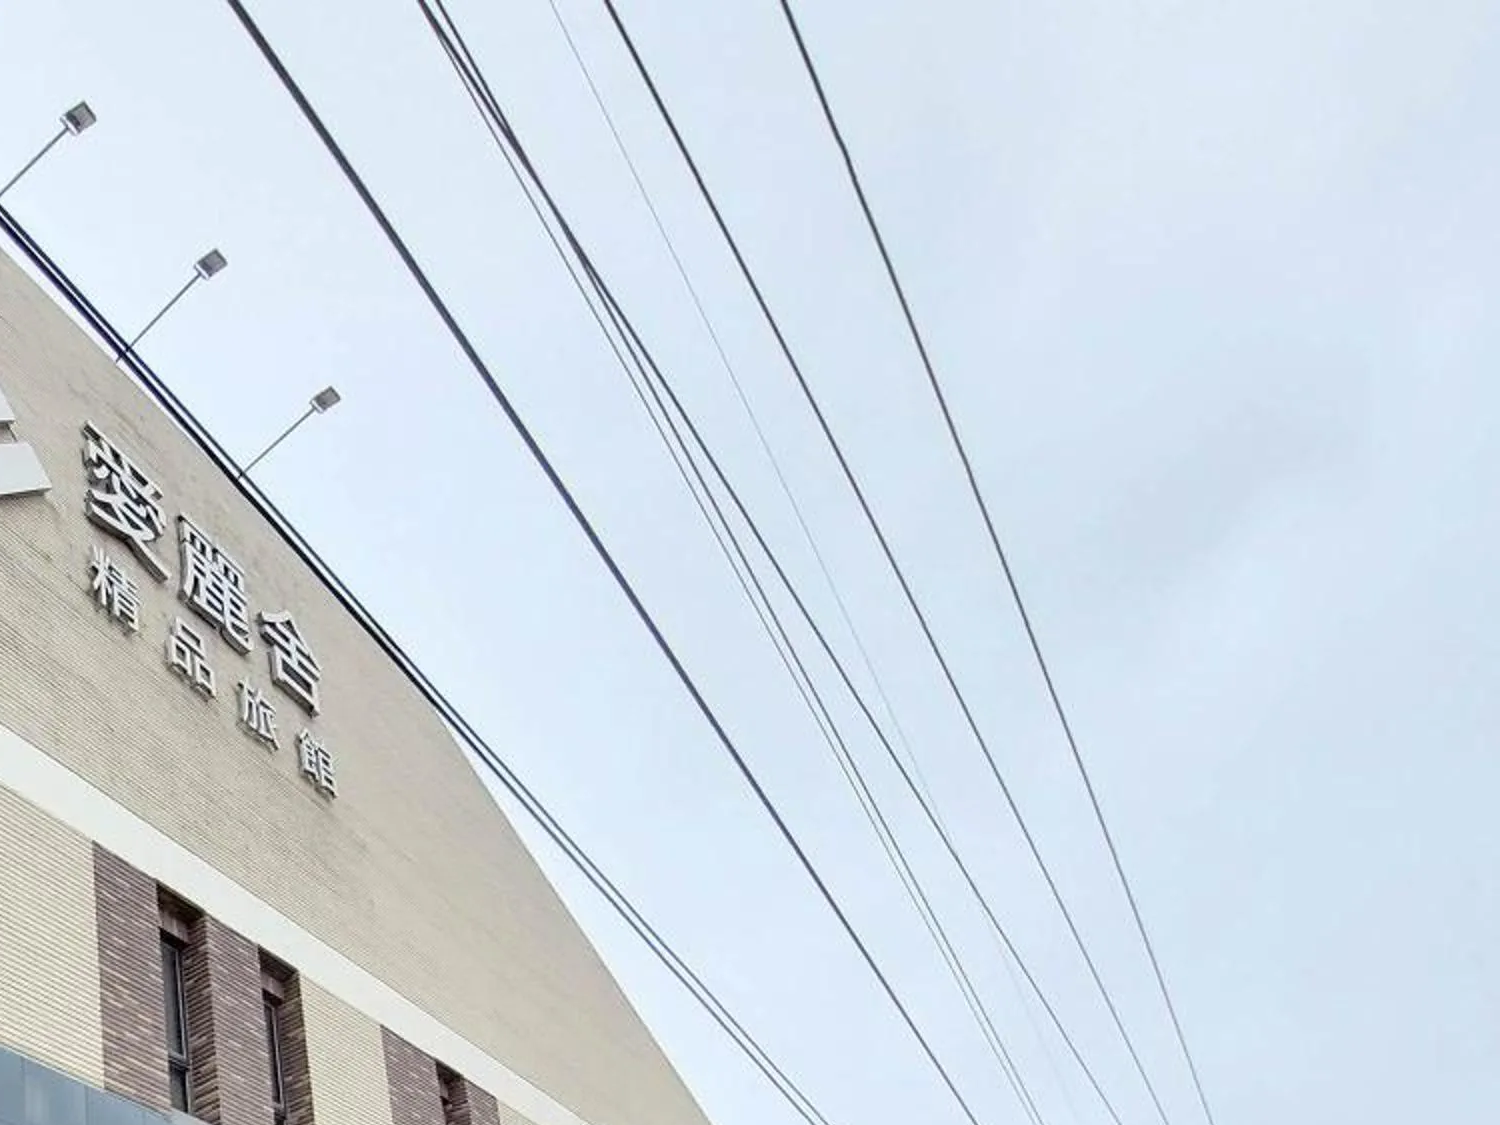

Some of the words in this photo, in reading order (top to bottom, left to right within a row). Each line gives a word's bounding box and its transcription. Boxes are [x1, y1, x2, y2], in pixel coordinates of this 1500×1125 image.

[82, 420, 322, 716] 愛麗舍
[89, 545, 338, 799] 精品旅館
